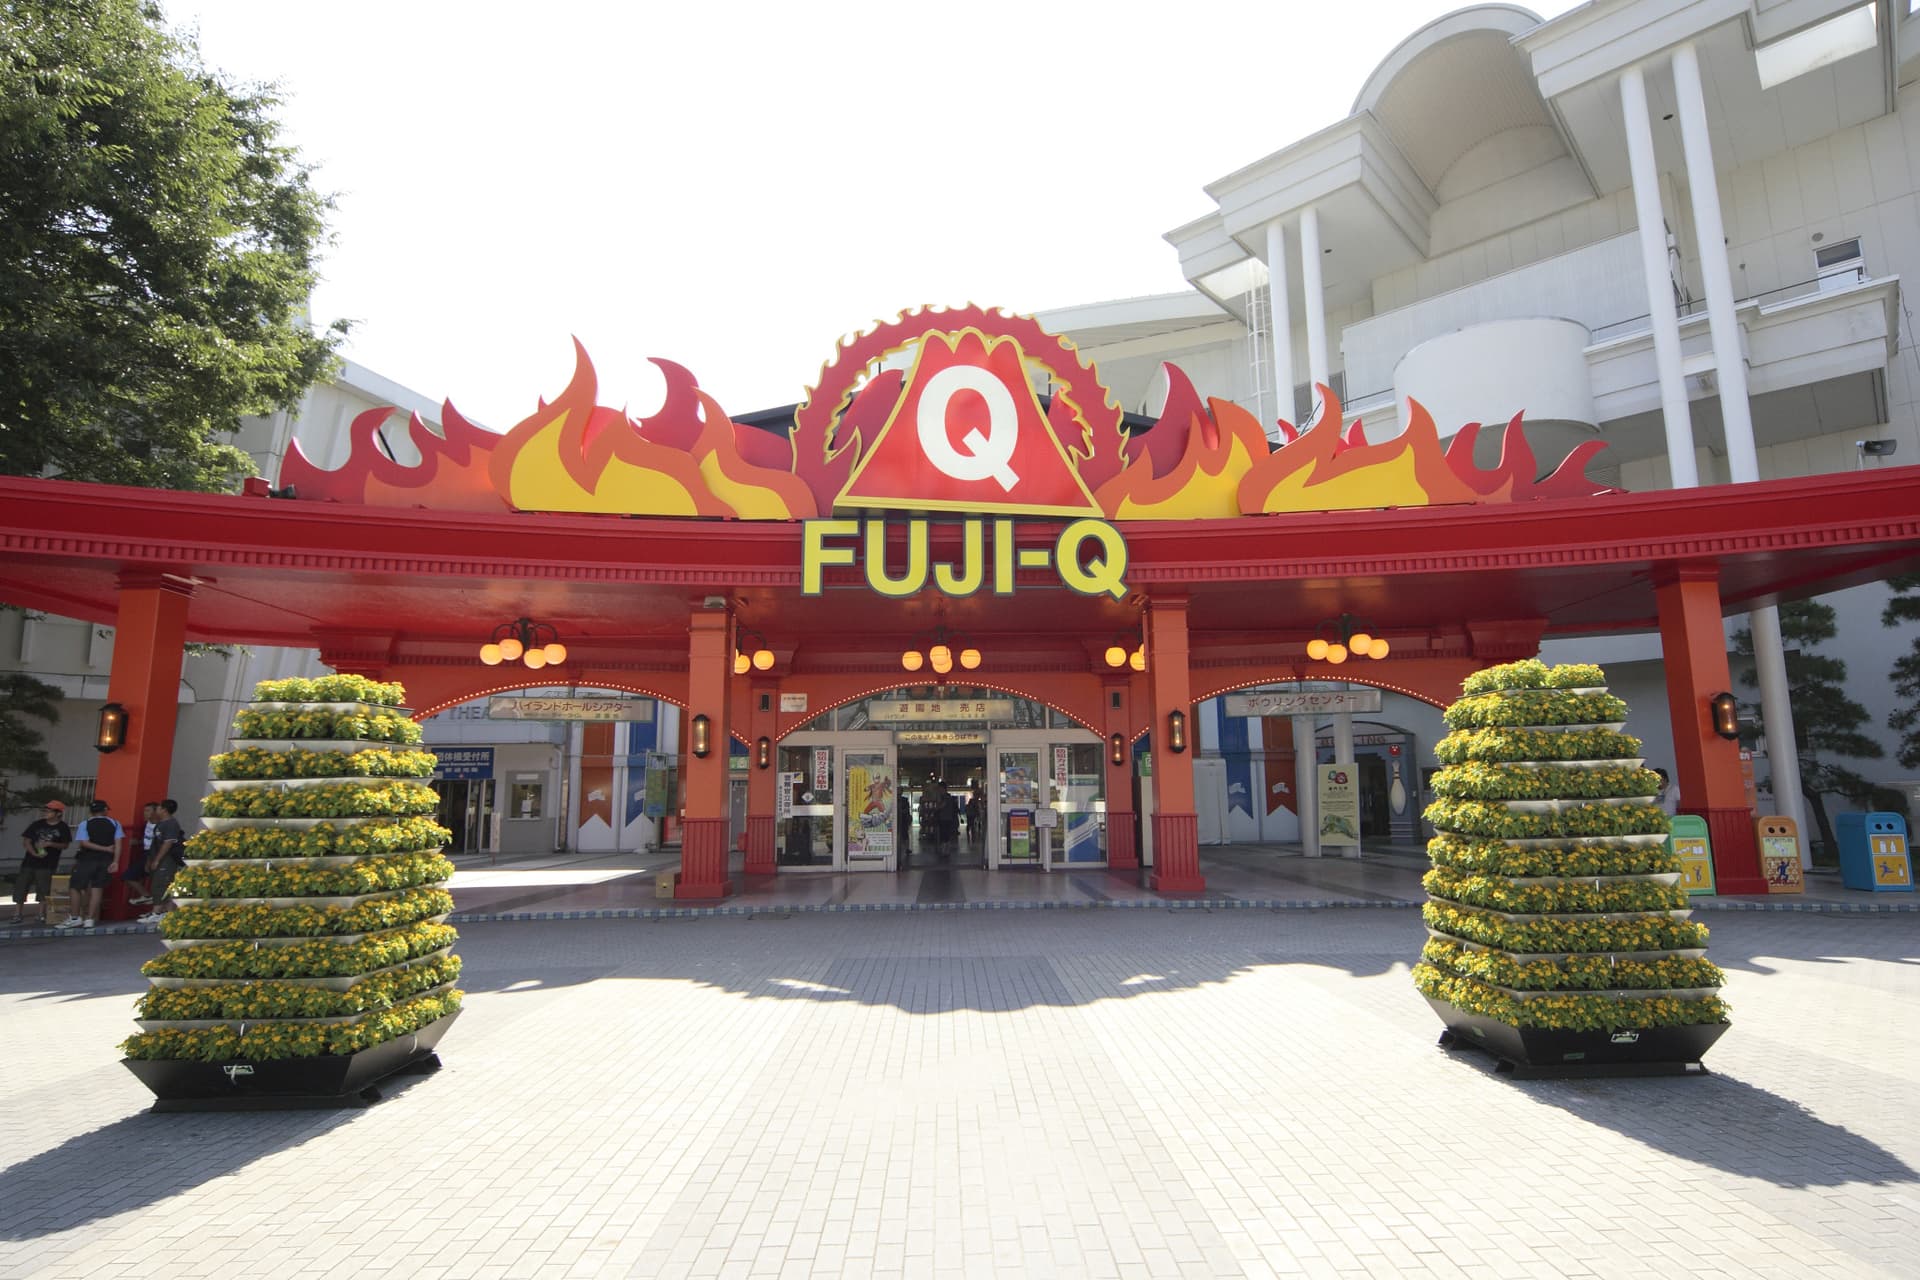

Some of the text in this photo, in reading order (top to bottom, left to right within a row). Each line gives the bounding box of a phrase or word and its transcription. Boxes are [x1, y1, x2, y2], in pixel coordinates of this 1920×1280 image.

[916, 364, 1021, 493] Q
[801, 518, 1129, 601] FUJI-Q
[512, 700, 633, 712] ハイランドホールシアター
[1248, 694, 1357, 707] ボウリングセンター
[899, 703, 986, 713] 遊園地 売店
